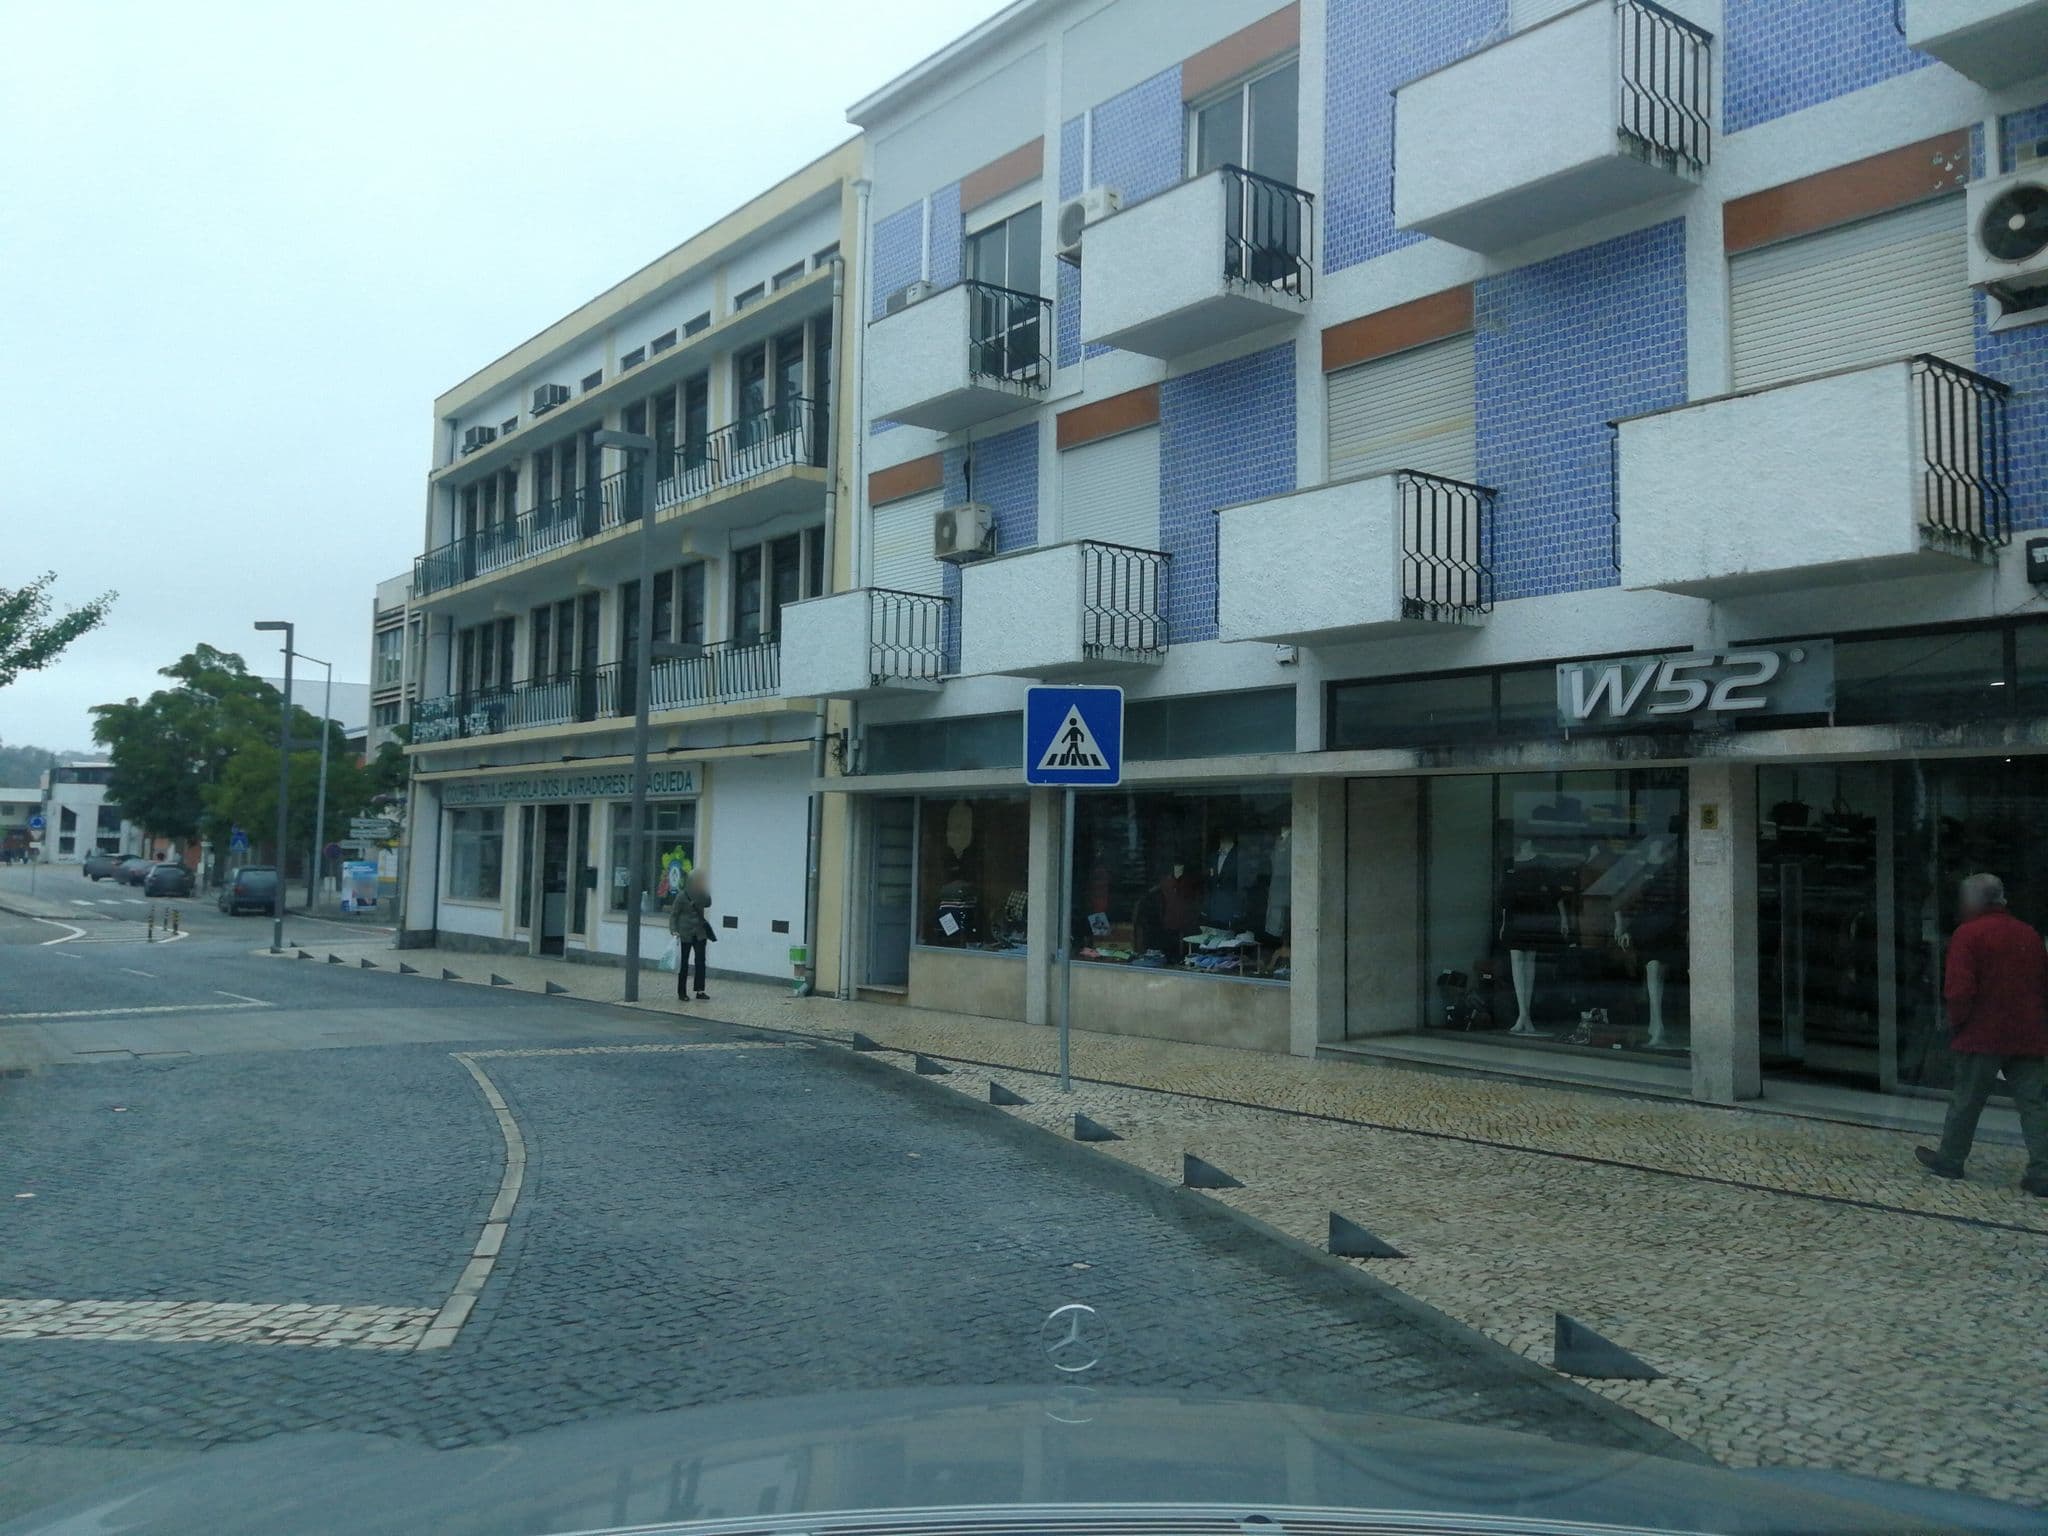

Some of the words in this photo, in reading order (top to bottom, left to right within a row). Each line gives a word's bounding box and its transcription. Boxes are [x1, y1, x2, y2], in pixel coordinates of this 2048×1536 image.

[1570, 650, 1780, 719] W52
[541, 778, 560, 797] DOS
[562, 773, 625, 796] LAVRADORES
